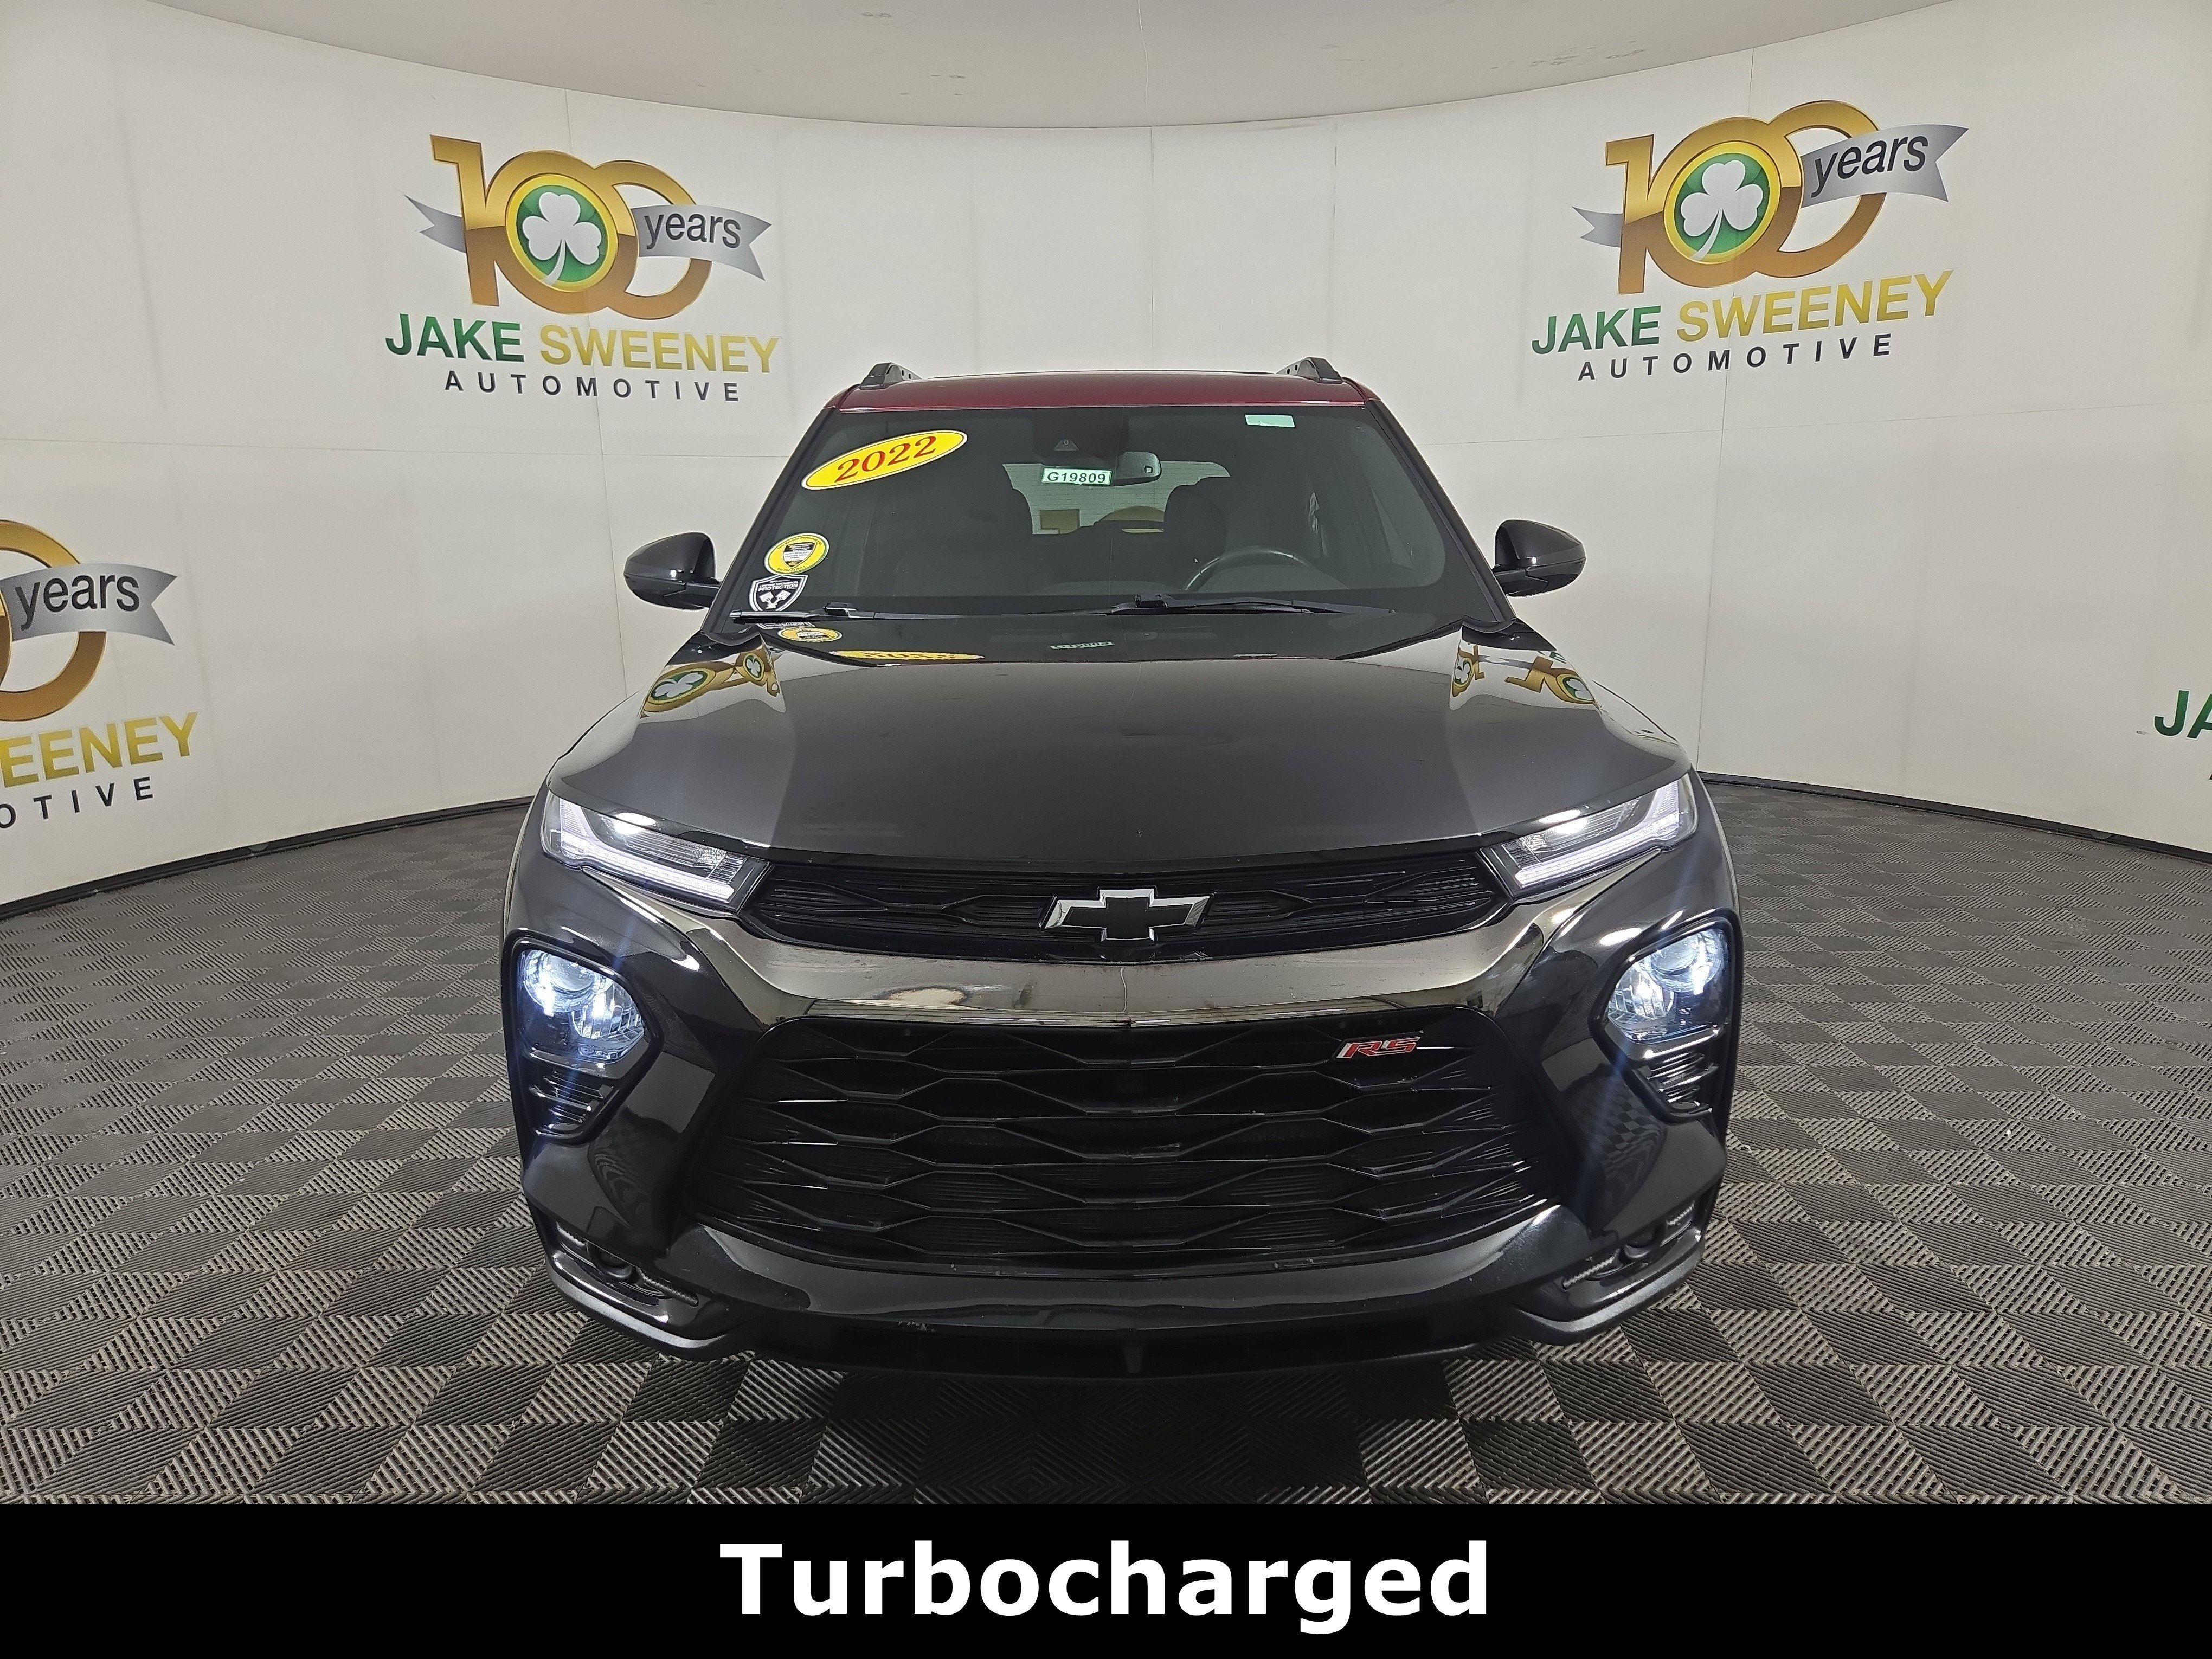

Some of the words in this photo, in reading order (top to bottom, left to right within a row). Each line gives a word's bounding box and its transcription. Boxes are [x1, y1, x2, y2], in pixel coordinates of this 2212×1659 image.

[1811, 135, 1928, 198] years
[644, 212, 741, 249] years
[1532, 306, 1661, 355] JAKE
[1677, 270, 1953, 343] SWEENEY
[385, 313, 525, 363] JAKE
[540, 324, 781, 374] SWEENEY
[1578, 333, 1892, 381] AUTOMOTIVE
[445, 371, 740, 401] AUTOMOTIVE
[834, 436, 936, 483] 2022
[1047, 472, 1106, 483] G19809
[15, 574, 140, 631] years
[758, 583, 799, 591] PROTECTION
[0, 712, 198, 788] EENEY
[1336, 1036, 1420, 1059] RS
